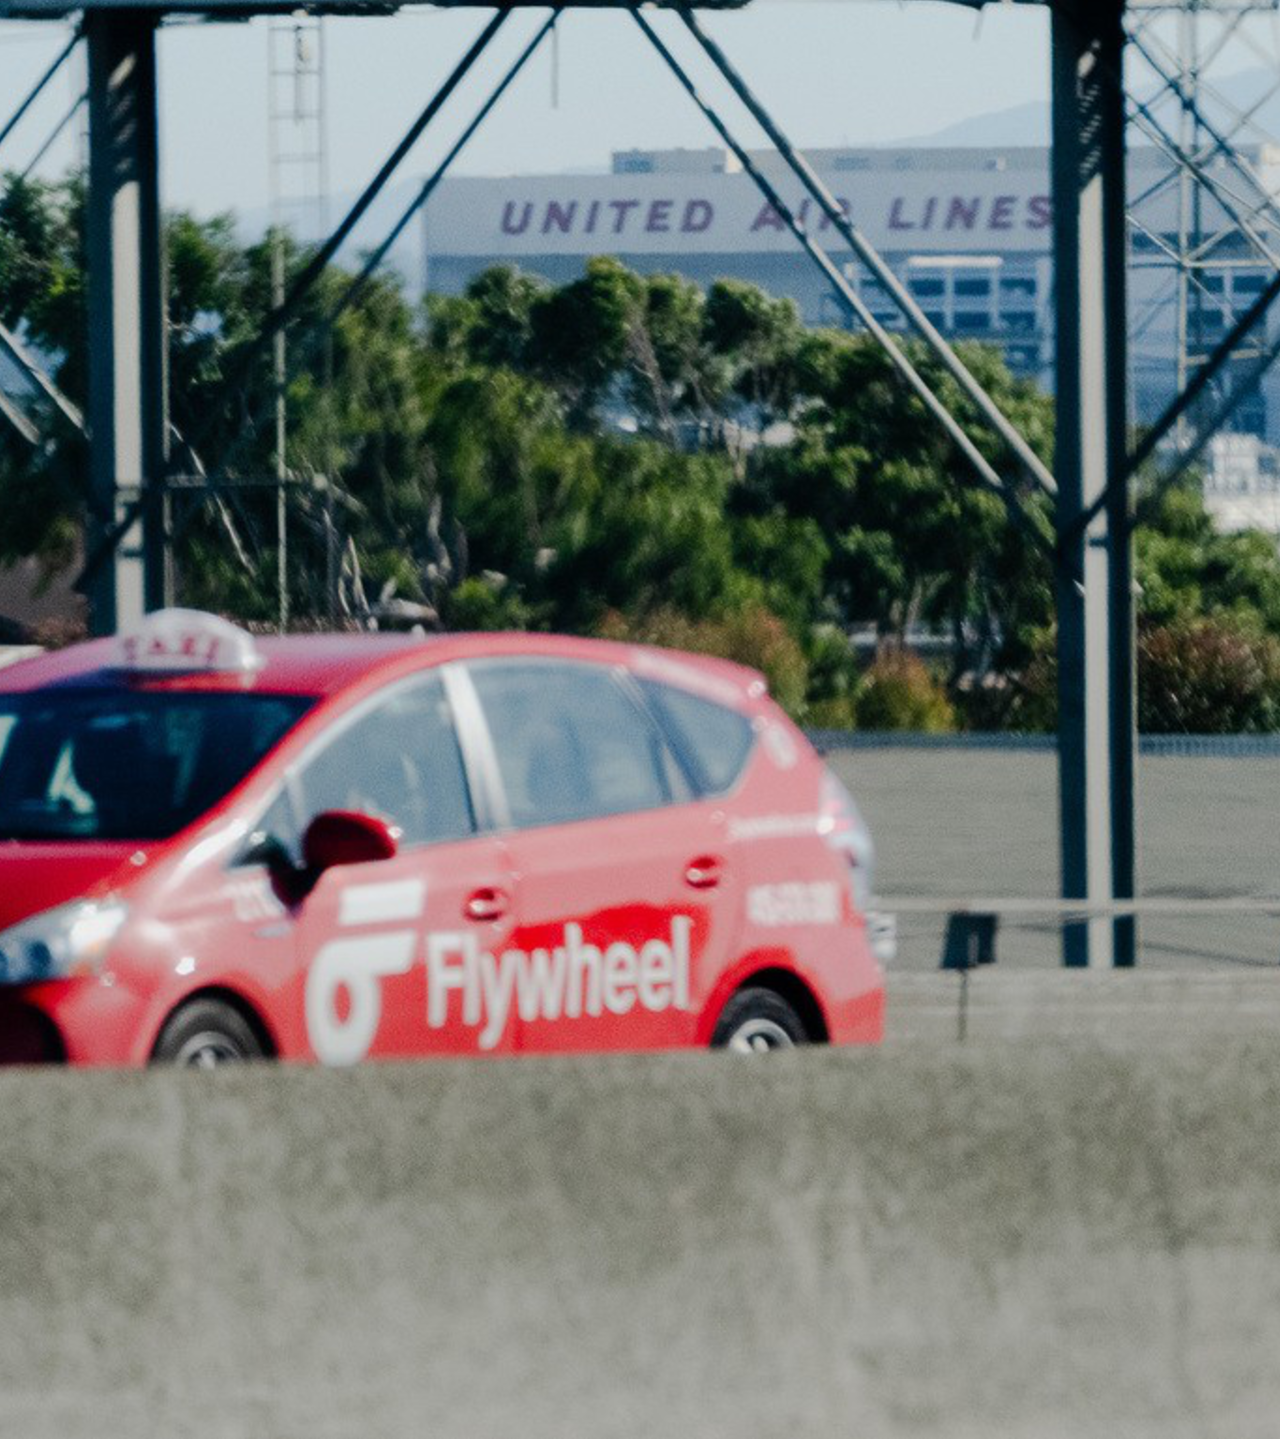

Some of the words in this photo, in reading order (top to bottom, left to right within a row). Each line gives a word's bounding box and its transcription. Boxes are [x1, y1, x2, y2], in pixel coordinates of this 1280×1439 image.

[500, 198, 715, 235] UNITED
[887, 195, 1053, 230] LINES
[426, 914, 691, 1050] Flywheel
